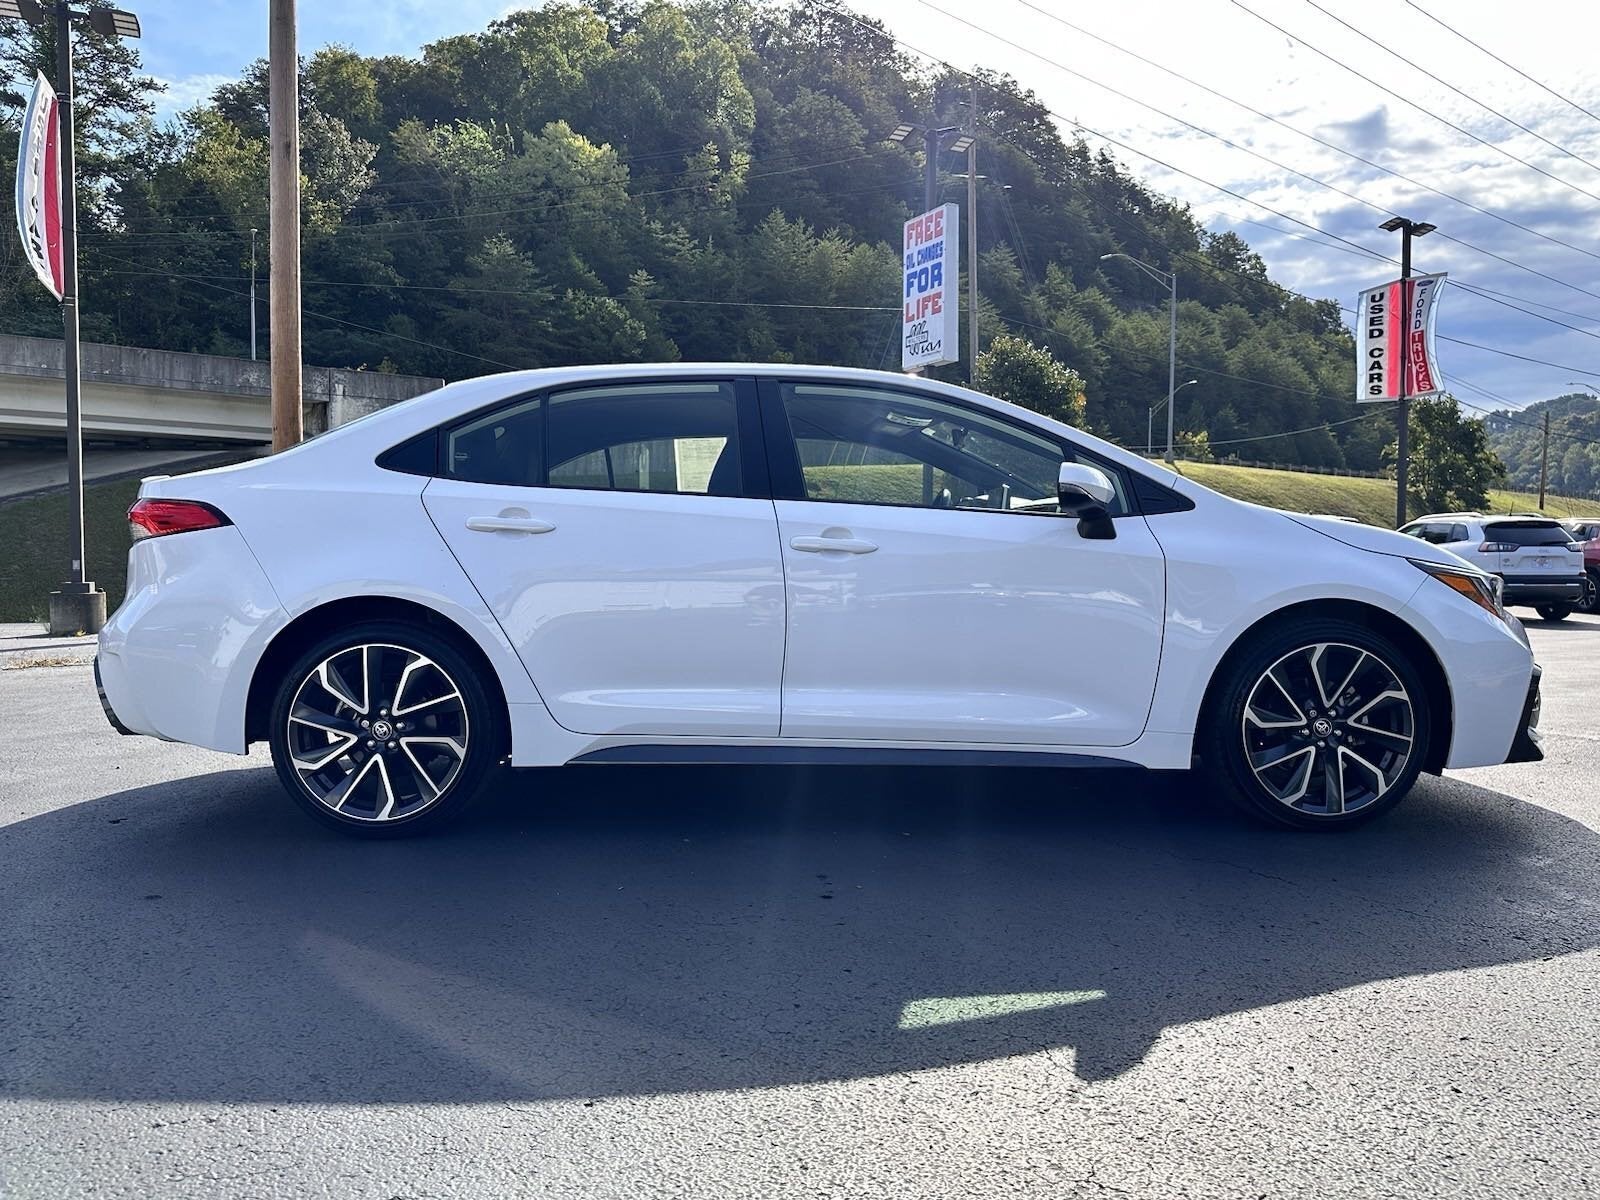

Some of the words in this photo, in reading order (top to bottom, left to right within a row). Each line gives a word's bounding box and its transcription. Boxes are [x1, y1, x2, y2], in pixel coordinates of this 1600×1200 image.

[906, 210, 944, 250] FREE
[917, 240, 943, 266] CHANGES
[906, 261, 943, 298] FOR
[905, 291, 943, 324] LIFE
[1368, 291, 1385, 339] USED
[1414, 288, 1427, 330] FORD
[1368, 347, 1384, 395] CARS
[1412, 332, 1431, 391] TRUCKS
